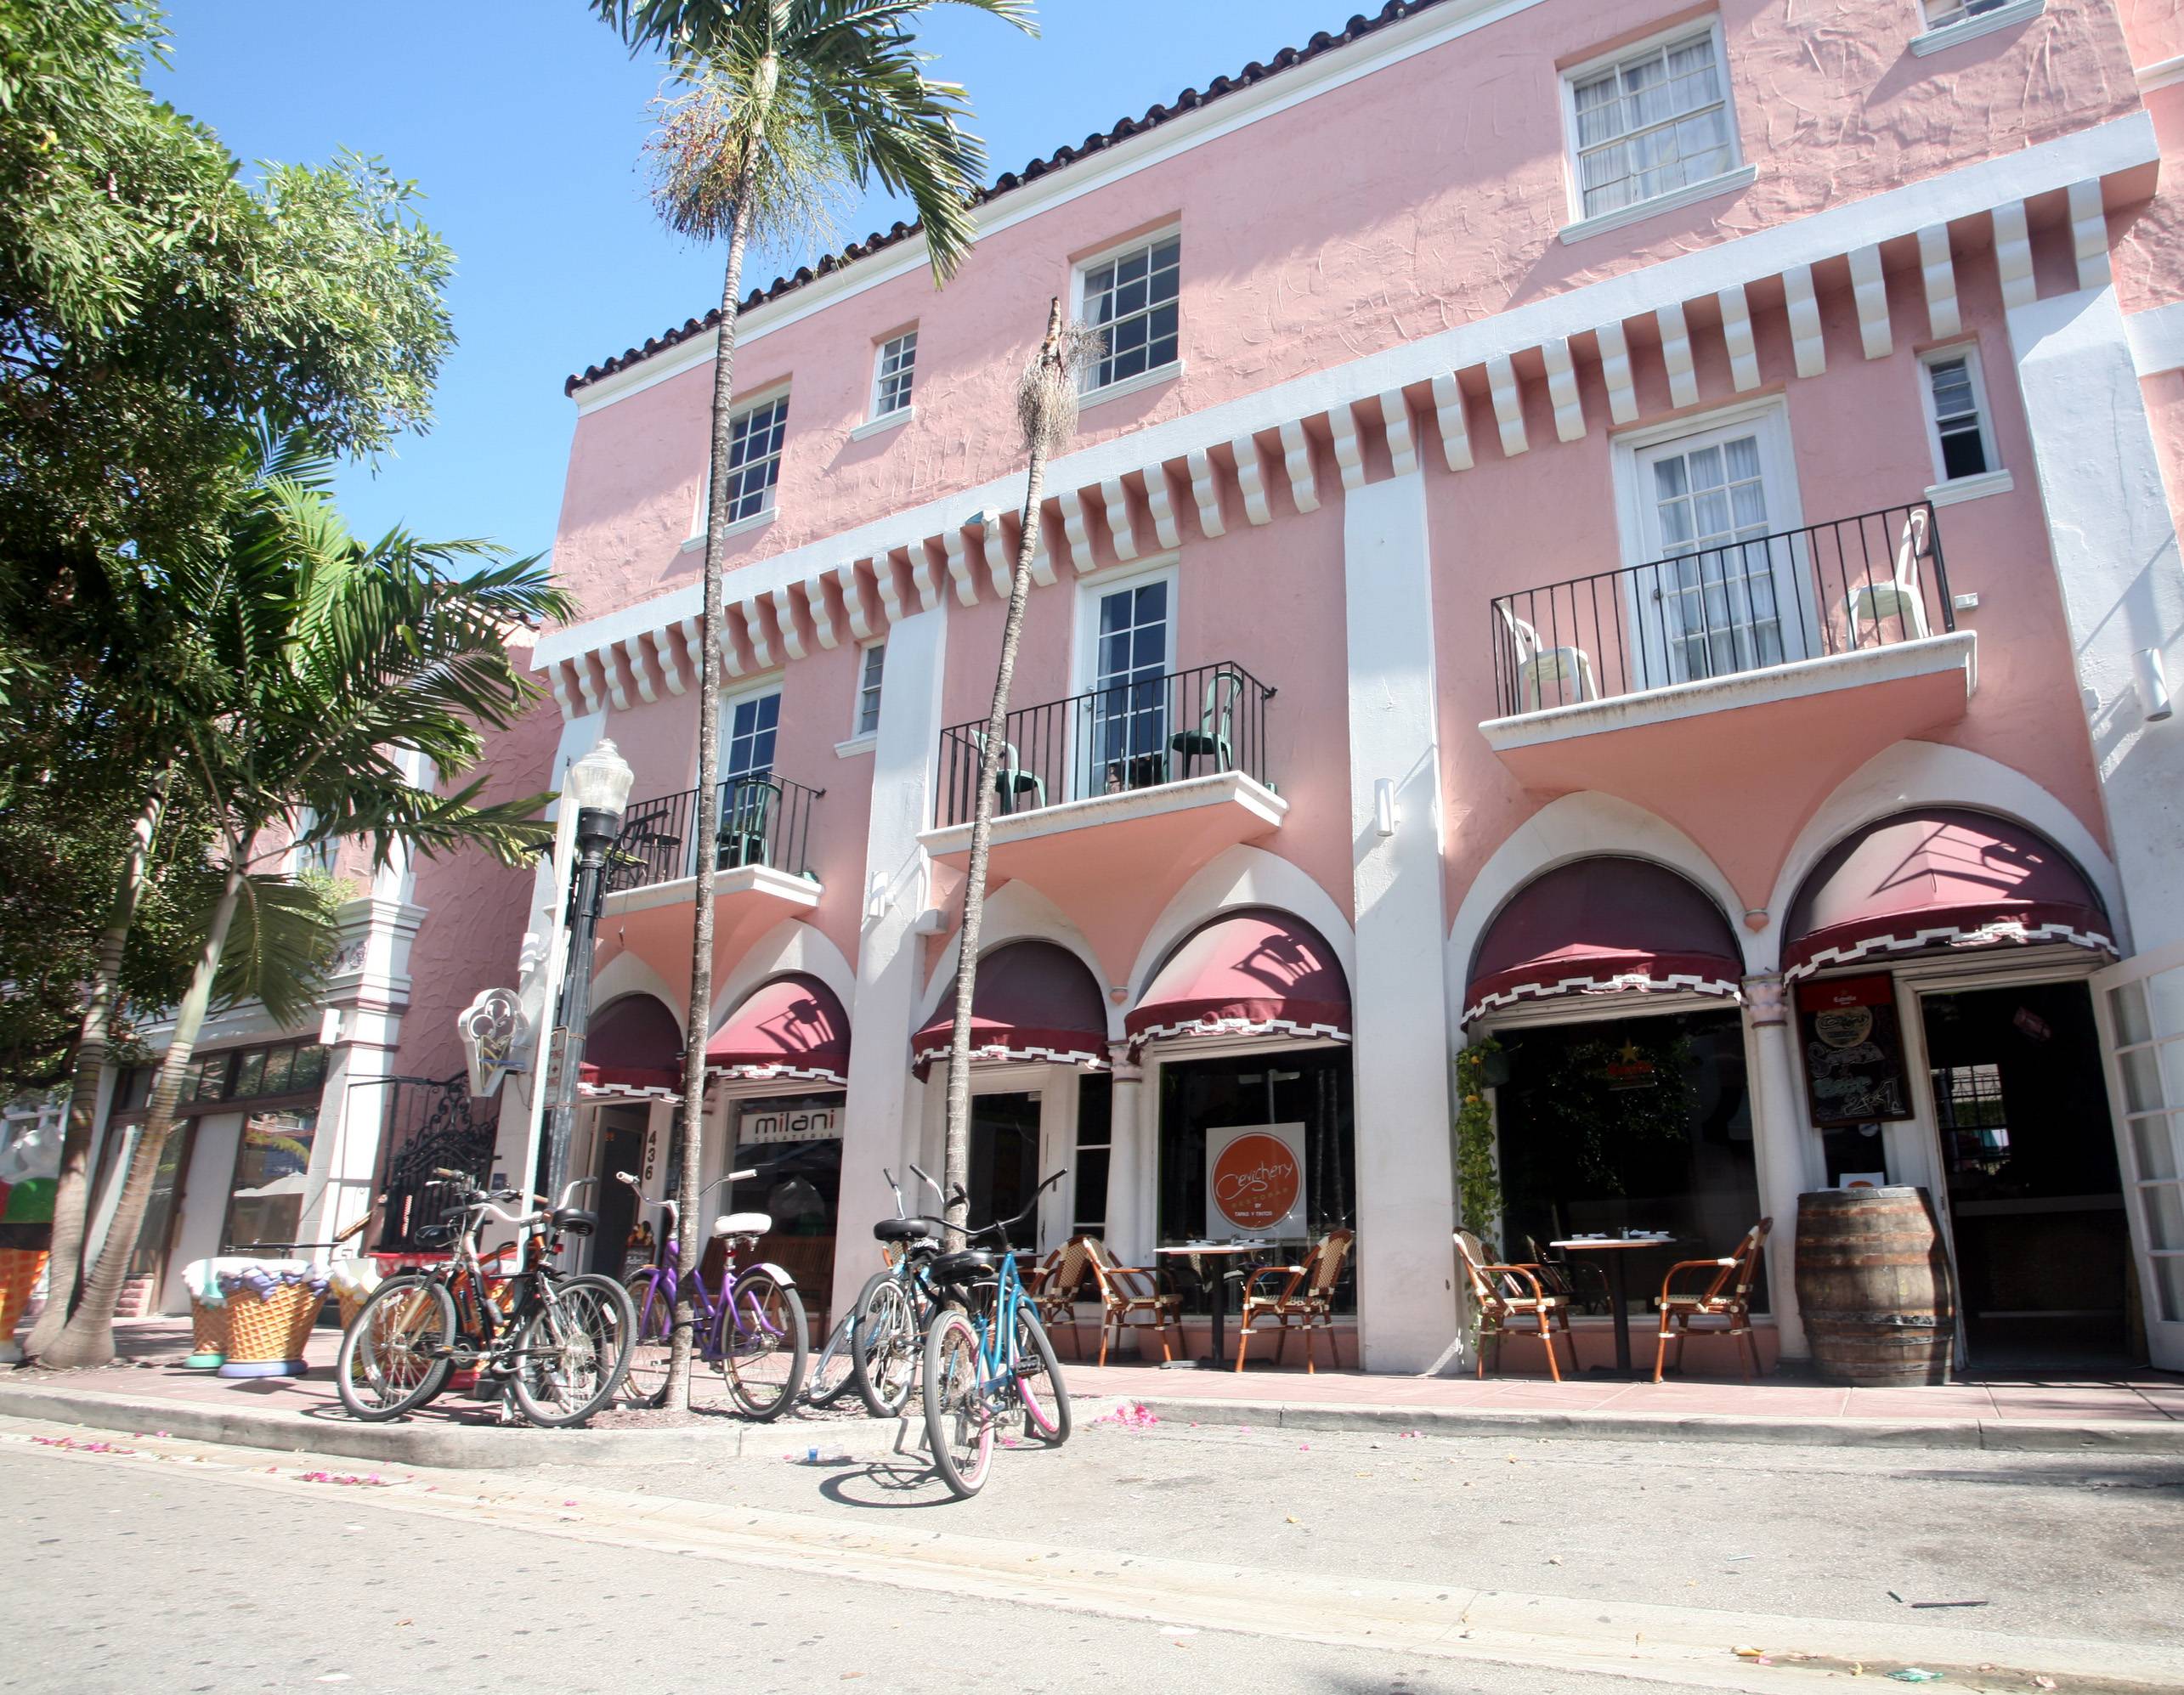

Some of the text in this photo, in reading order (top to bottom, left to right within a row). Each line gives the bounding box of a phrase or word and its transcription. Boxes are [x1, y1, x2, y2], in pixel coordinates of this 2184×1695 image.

[755, 1110, 835, 1134] milani
[644, 1130, 657, 1180] 436
[1215, 1161, 1293, 1201] Cevichery
